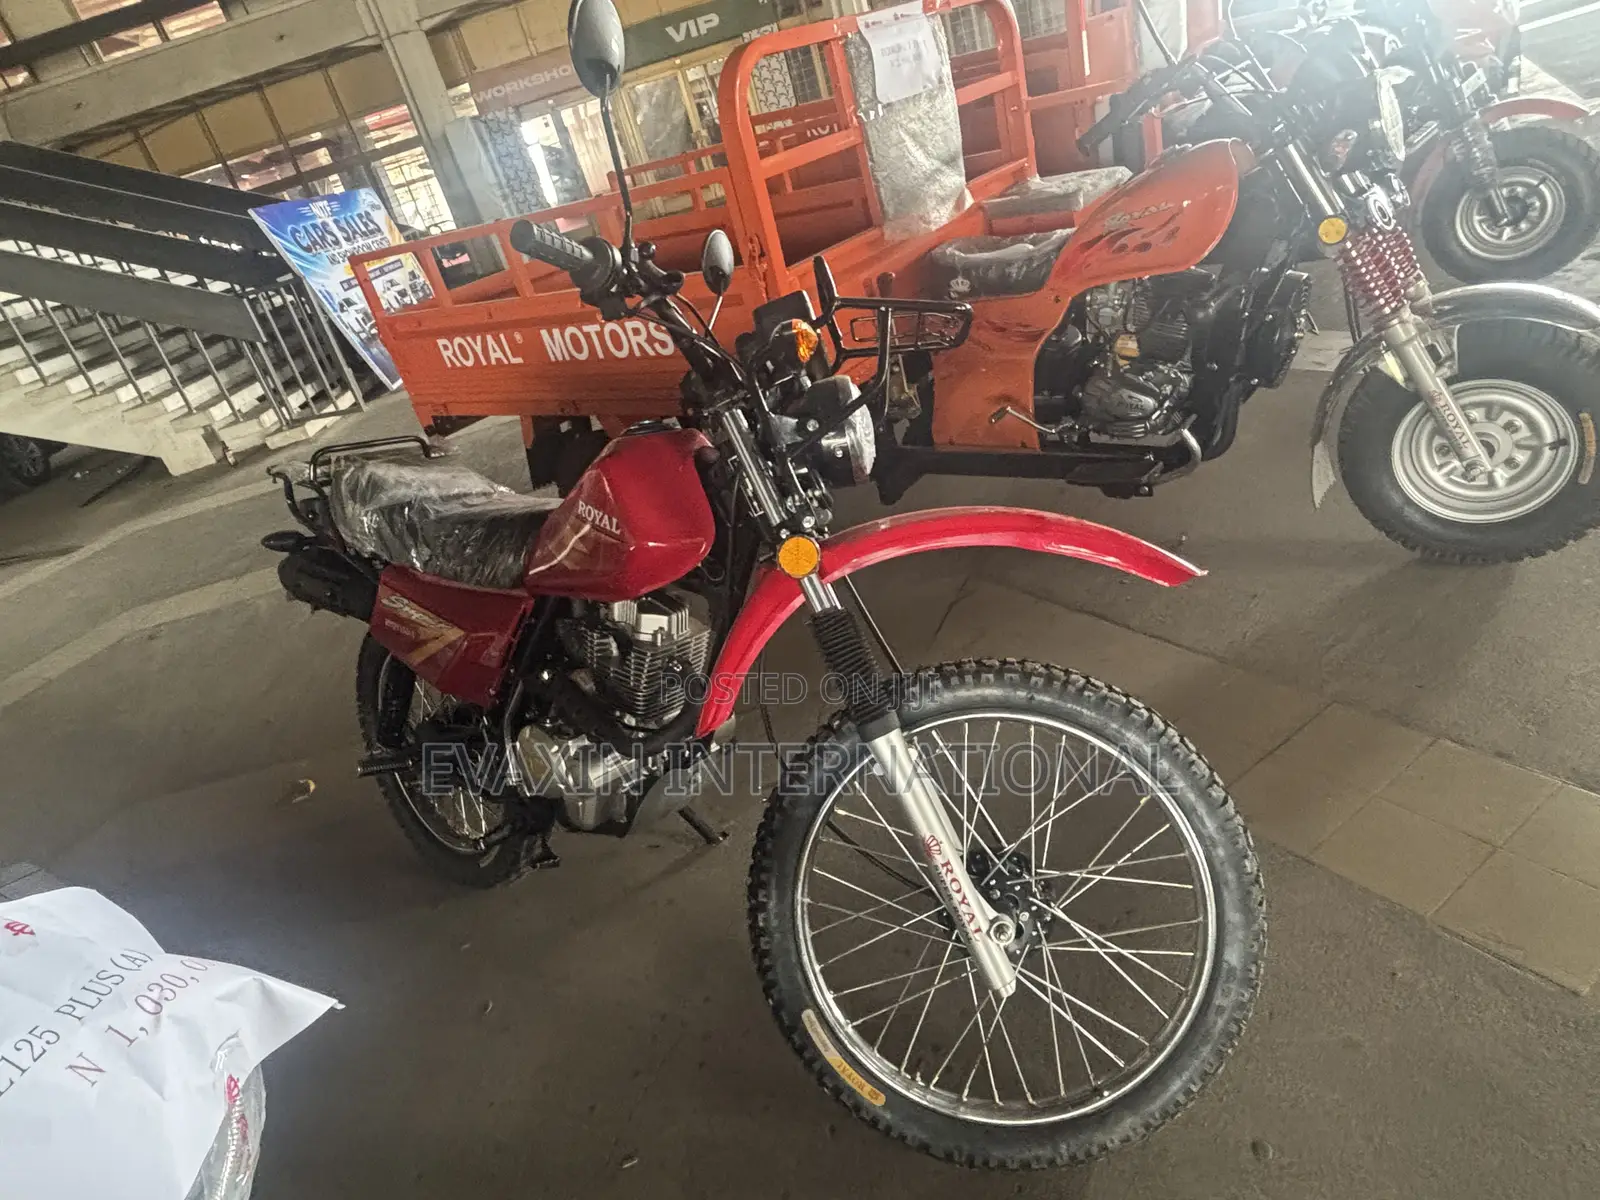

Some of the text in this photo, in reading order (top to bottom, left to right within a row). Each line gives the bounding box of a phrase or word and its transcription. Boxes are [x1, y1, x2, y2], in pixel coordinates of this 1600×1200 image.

[665, 13, 720, 43] VIP
[472, 64, 573, 103] WORKSHO
[289, 210, 383, 254] CARS SALES
[540, 320, 675, 363] MOTORS
[1440, 403, 1470, 449] ROYAL
[577, 499, 621, 536] ROYAL
[940, 859, 984, 942] ROYAL
[54, 948, 154, 1021] PLUS(A)
[105, 958, 215, 1048] 1,030,0
